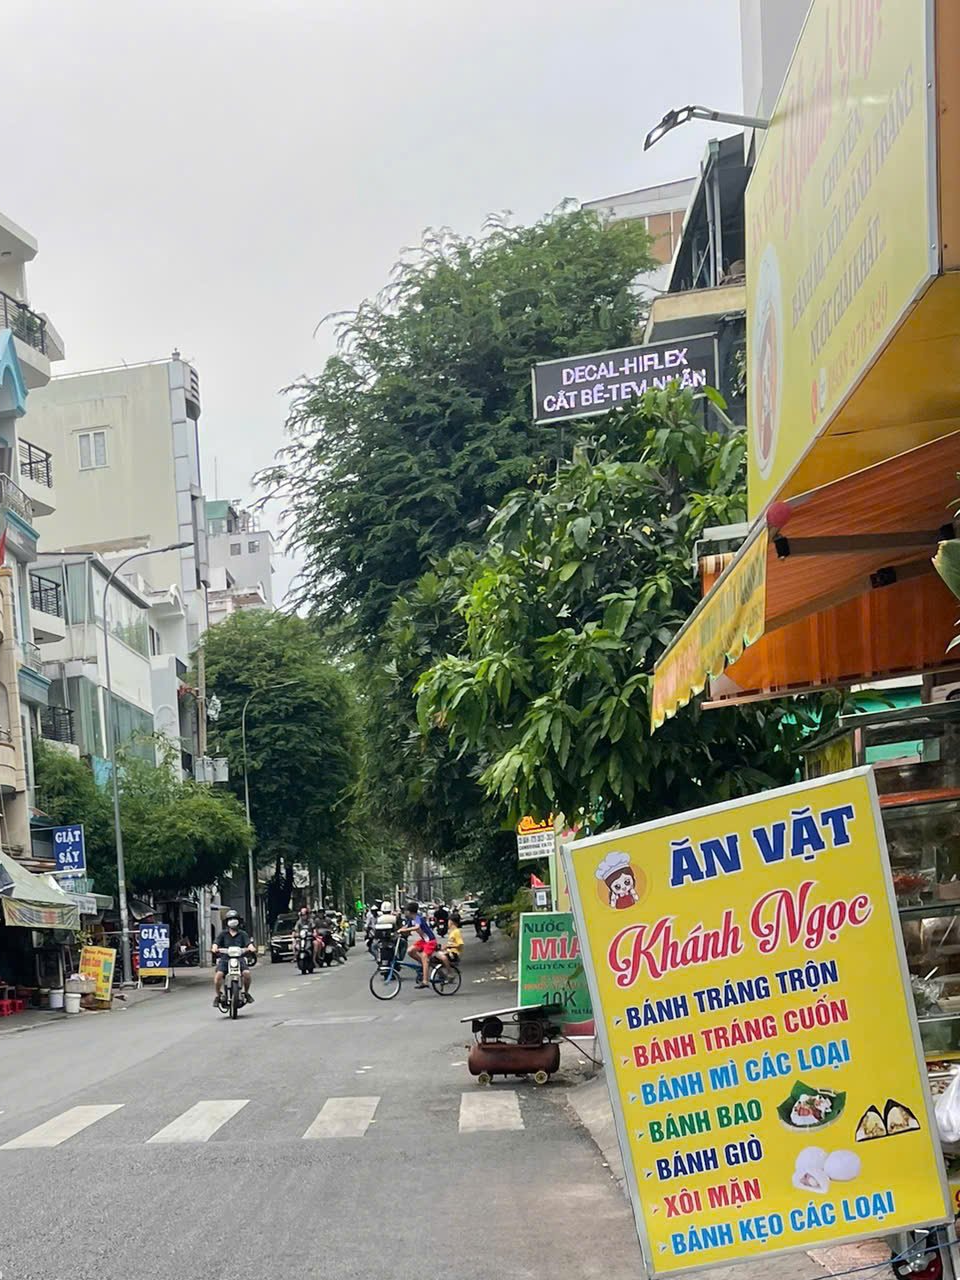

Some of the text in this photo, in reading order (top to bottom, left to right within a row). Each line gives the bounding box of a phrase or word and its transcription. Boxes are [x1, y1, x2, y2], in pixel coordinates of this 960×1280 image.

[562, 348, 688, 385] DECAL-HIFLEX
[55, 828, 81, 845] GIẶT
[59, 846, 80, 864] SẤY
[670, 805, 855, 887] ĂN VẶT
[524, 920, 565, 933] NƯỚC
[608, 880, 873, 988] Khánh Ngọc
[542, 990, 577, 1007] 10K
[626, 960, 839, 1029] BÁNH TRÁNG TRỘN
[633, 994, 849, 1067] BÁNH TRÁNG CUỐN
[641, 1039, 851, 1105] BÁNH MÌ CÁC LOẠI
[648, 1099, 763, 1143] BÁNH BAO
[656, 1134, 763, 1181] BÁNH GIÒ
[664, 1178, 762, 1218] XÔI MẶN
[671, 1191, 895, 1255] BÁNH KẸO CÁC LOẠI
